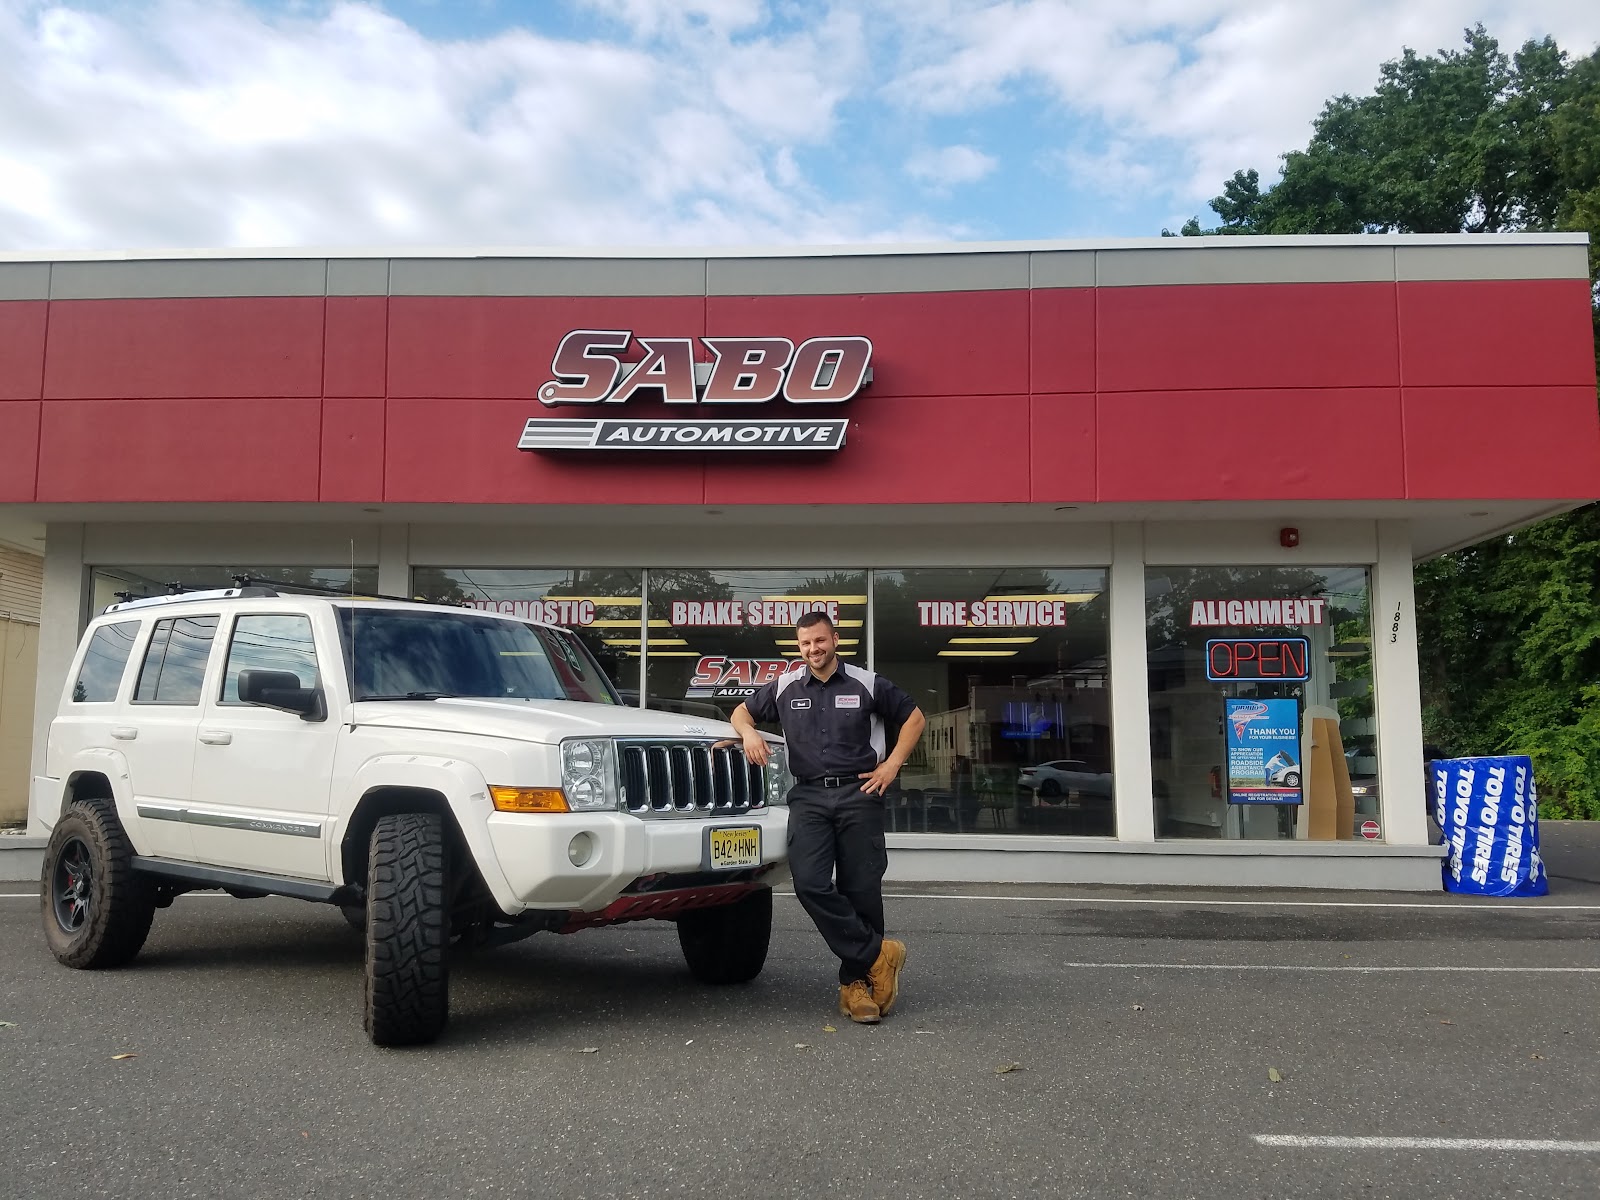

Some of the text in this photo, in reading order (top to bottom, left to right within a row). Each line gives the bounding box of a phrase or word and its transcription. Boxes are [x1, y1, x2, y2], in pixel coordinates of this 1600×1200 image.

[537, 329, 873, 407] SABO
[606, 426, 833, 442] AUTOMOTIVE
[462, 600, 595, 625] AGNOSTIC
[672, 601, 744, 626] BRAKE
[918, 601, 1067, 626] TIRE SERVICE
[1190, 599, 1325, 626] ALIGNMENT
[1391, 601, 1400, 643] 1883
[1210, 642, 1304, 676] OPEN
[1453, 768, 1475, 827] TOYO
[734, 830, 747, 838] Jersey
[1471, 766, 1506, 886] TOYO TIRES
[1500, 765, 1527, 886] TOYO TIRES
